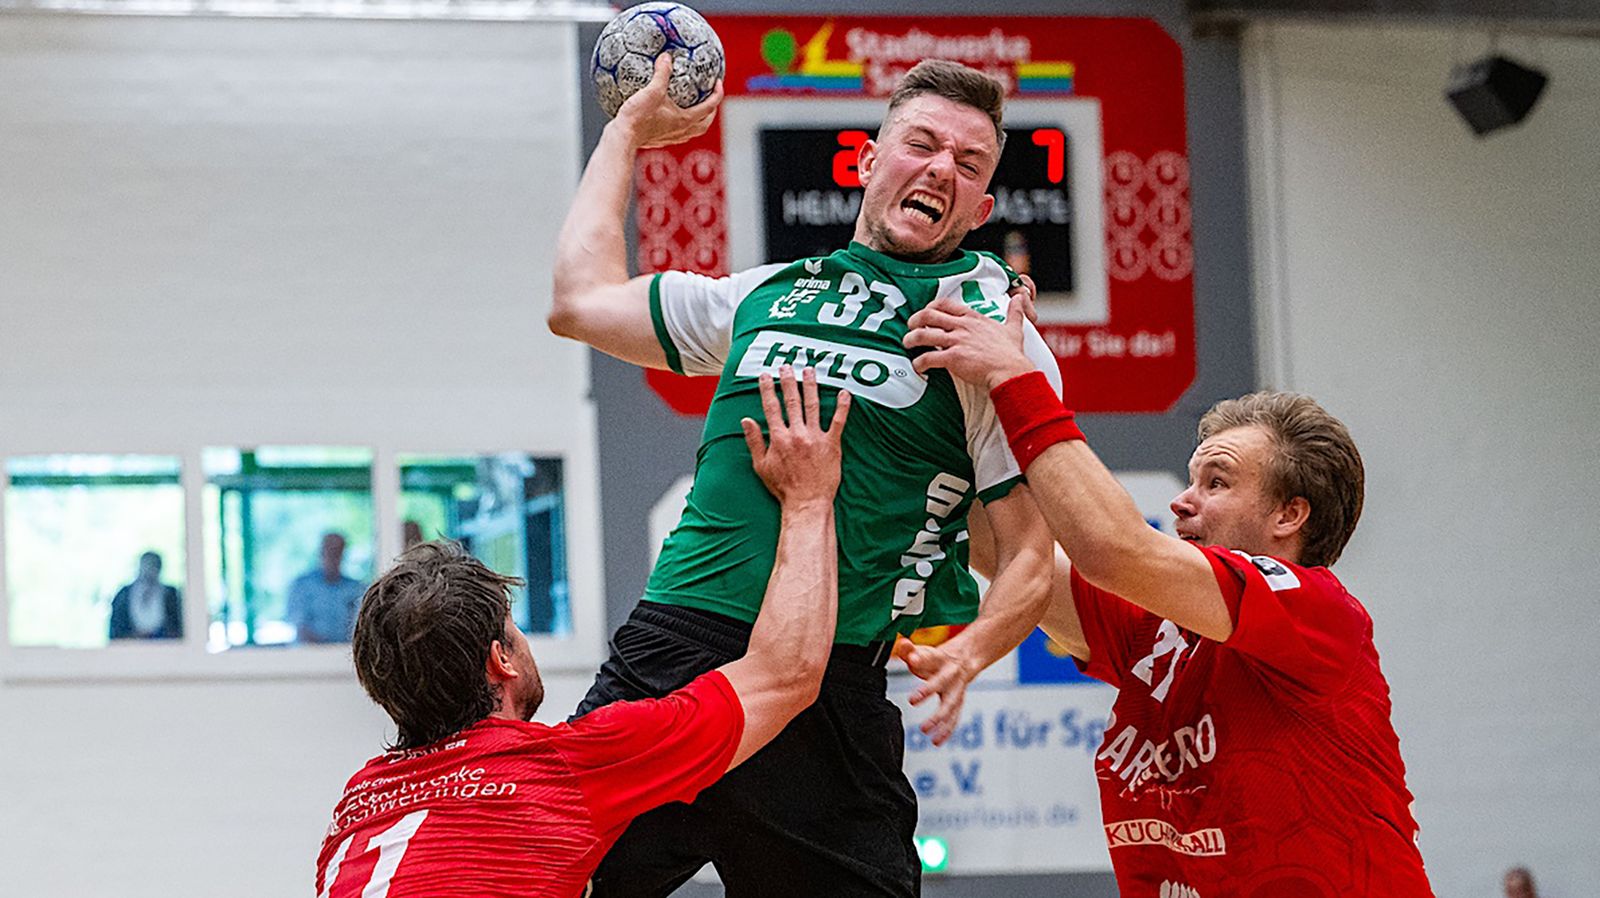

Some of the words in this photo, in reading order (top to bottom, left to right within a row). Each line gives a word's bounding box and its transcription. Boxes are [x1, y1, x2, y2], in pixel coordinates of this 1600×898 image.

[1032, 129, 1064, 183] 7
[986, 185, 1070, 224] ÄSTE
[817, 272, 906, 332] 37
